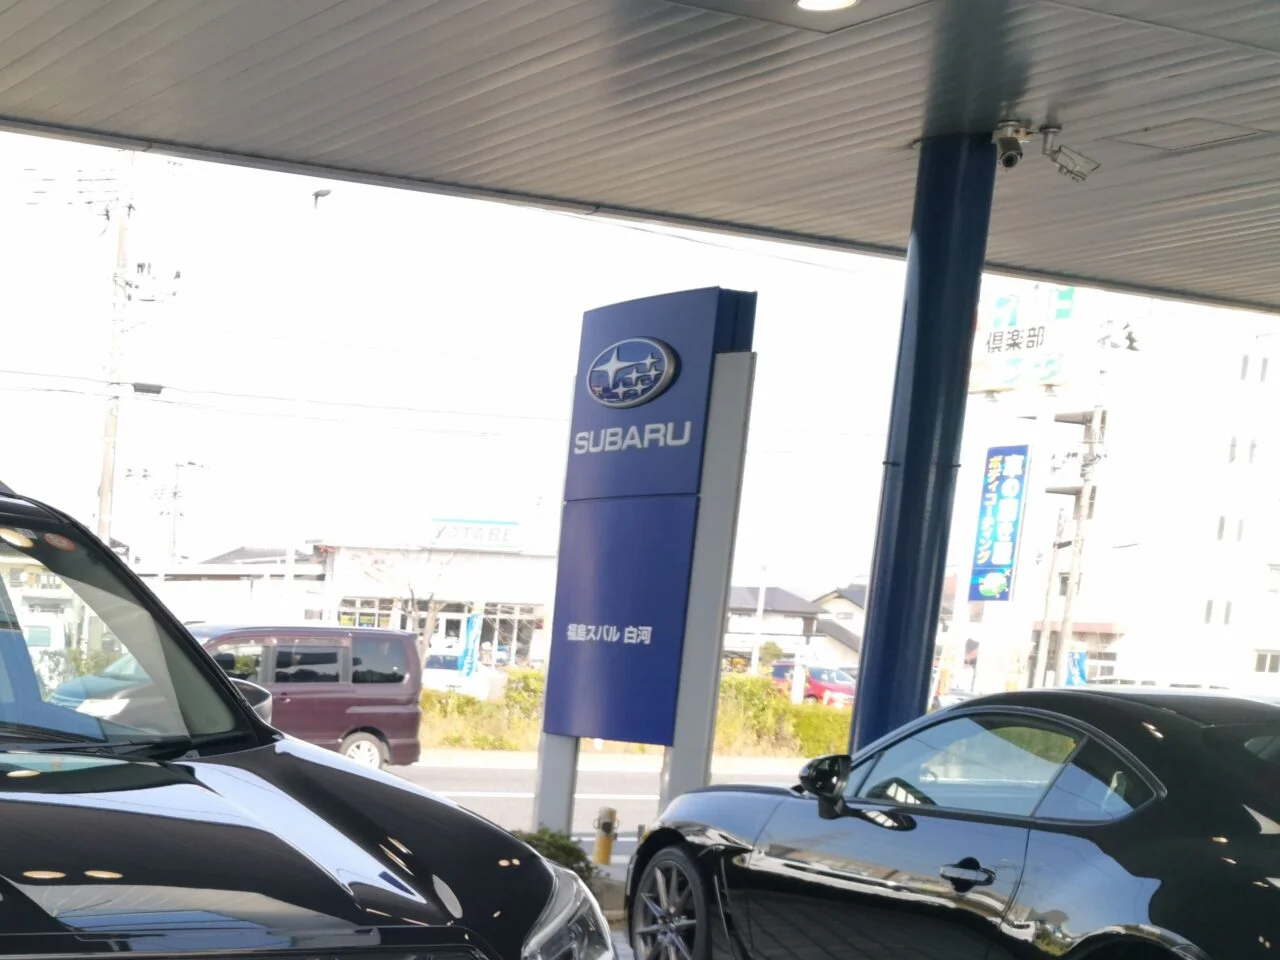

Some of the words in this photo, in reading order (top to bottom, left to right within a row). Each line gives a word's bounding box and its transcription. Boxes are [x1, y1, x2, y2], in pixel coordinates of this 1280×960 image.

[573, 420, 692, 455] SUBARU
[567, 623, 621, 642] 福島スバル
[623, 625, 653, 645] 白河
